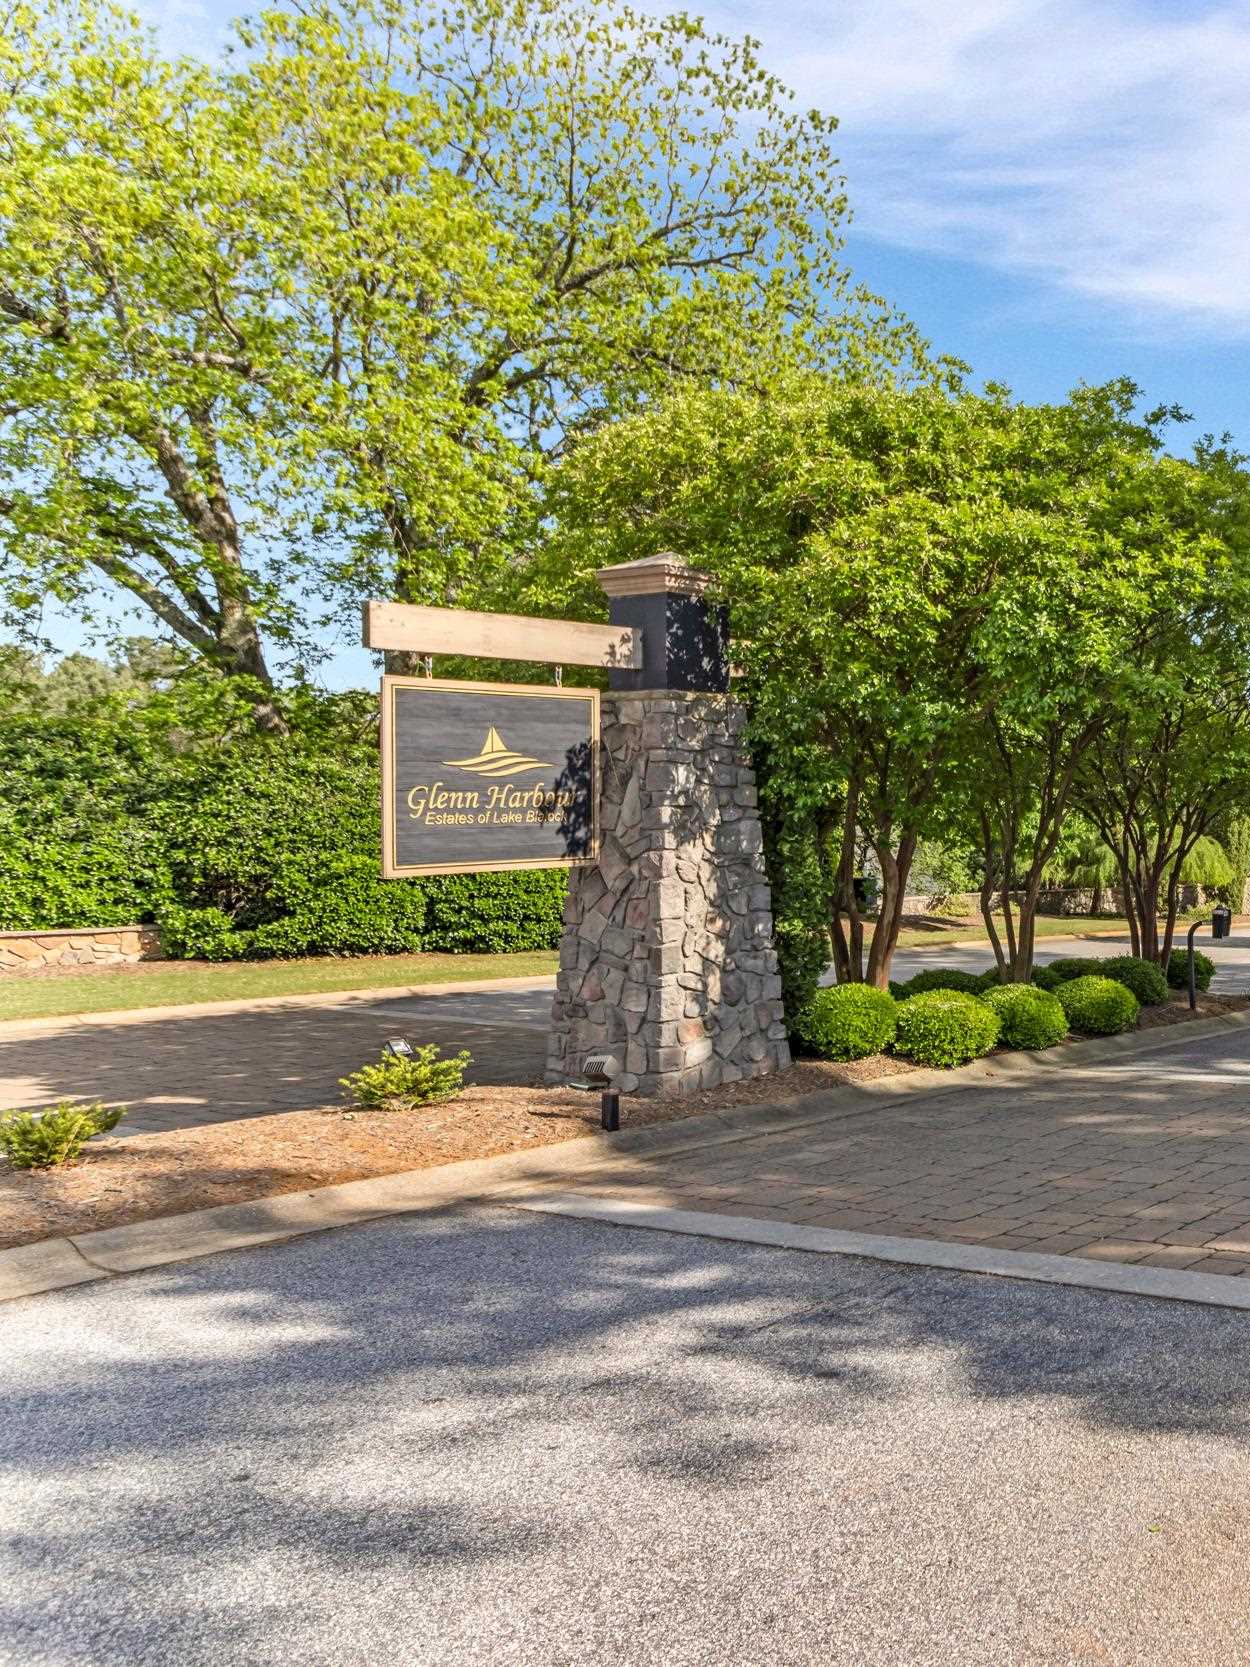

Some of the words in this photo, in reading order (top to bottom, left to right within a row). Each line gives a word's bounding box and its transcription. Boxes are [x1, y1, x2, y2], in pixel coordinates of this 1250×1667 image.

[407, 782, 480, 819] Glenn
[425, 811, 474, 825] Estates
[477, 811, 491, 824] of
[493, 811, 523, 824] Lake
[526, 810, 568, 824] Blaock
